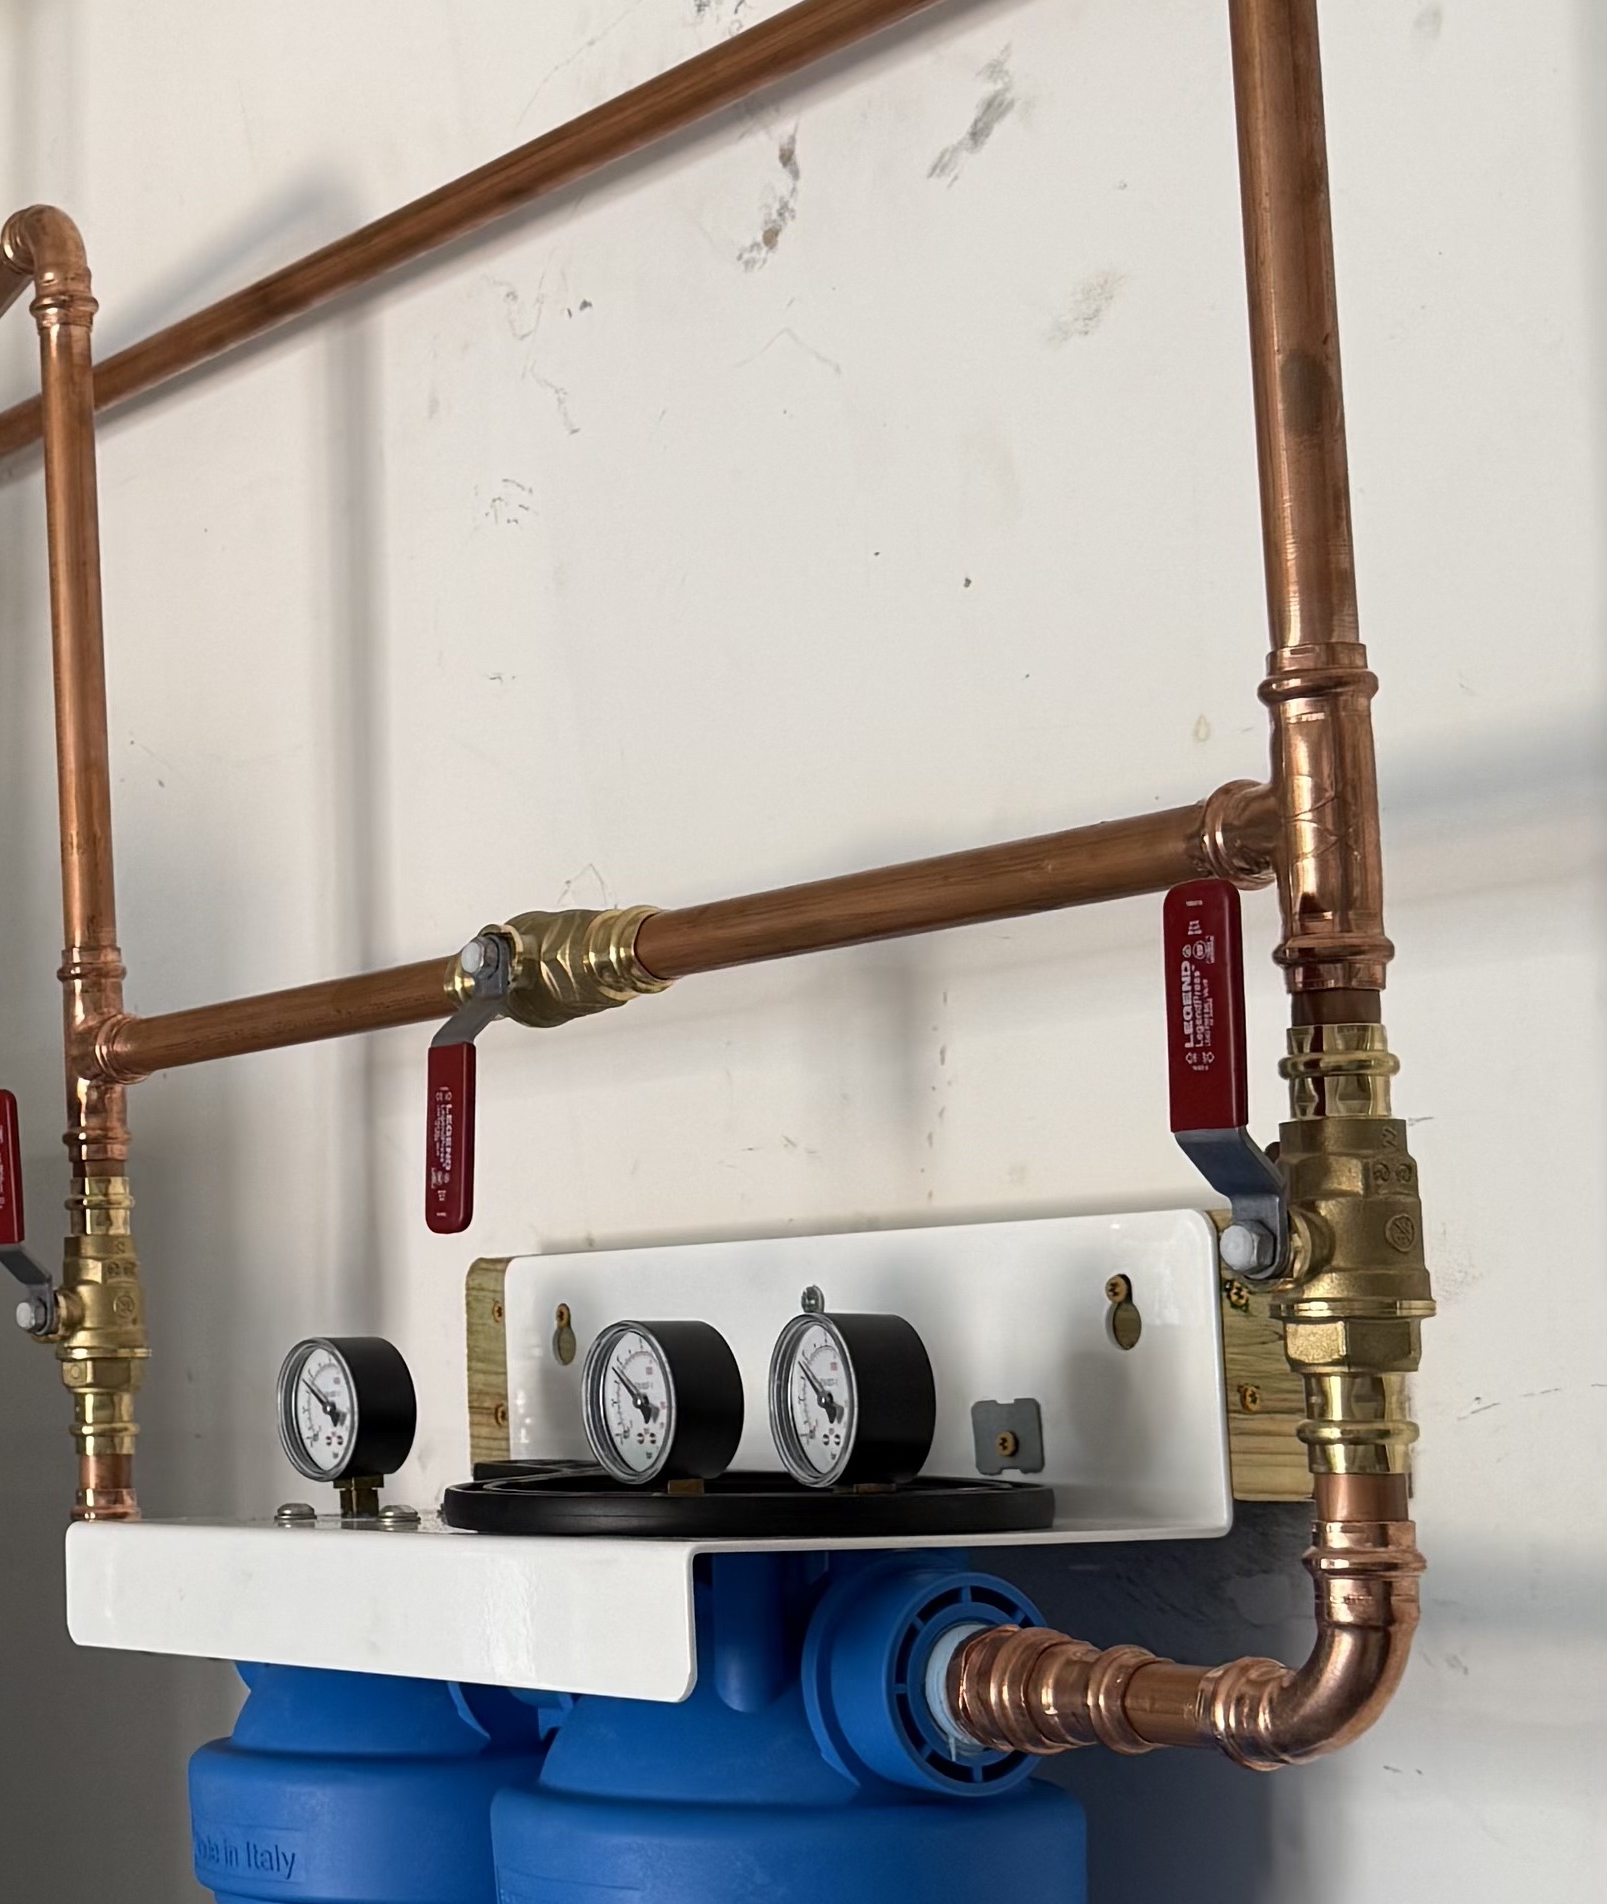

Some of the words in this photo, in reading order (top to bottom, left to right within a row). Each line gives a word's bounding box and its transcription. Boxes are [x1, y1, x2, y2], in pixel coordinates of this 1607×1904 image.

[1181, 960, 1195, 1049] LEGEND
[223, 1837, 239, 1868] in
[246, 1840, 296, 1881] Italy
